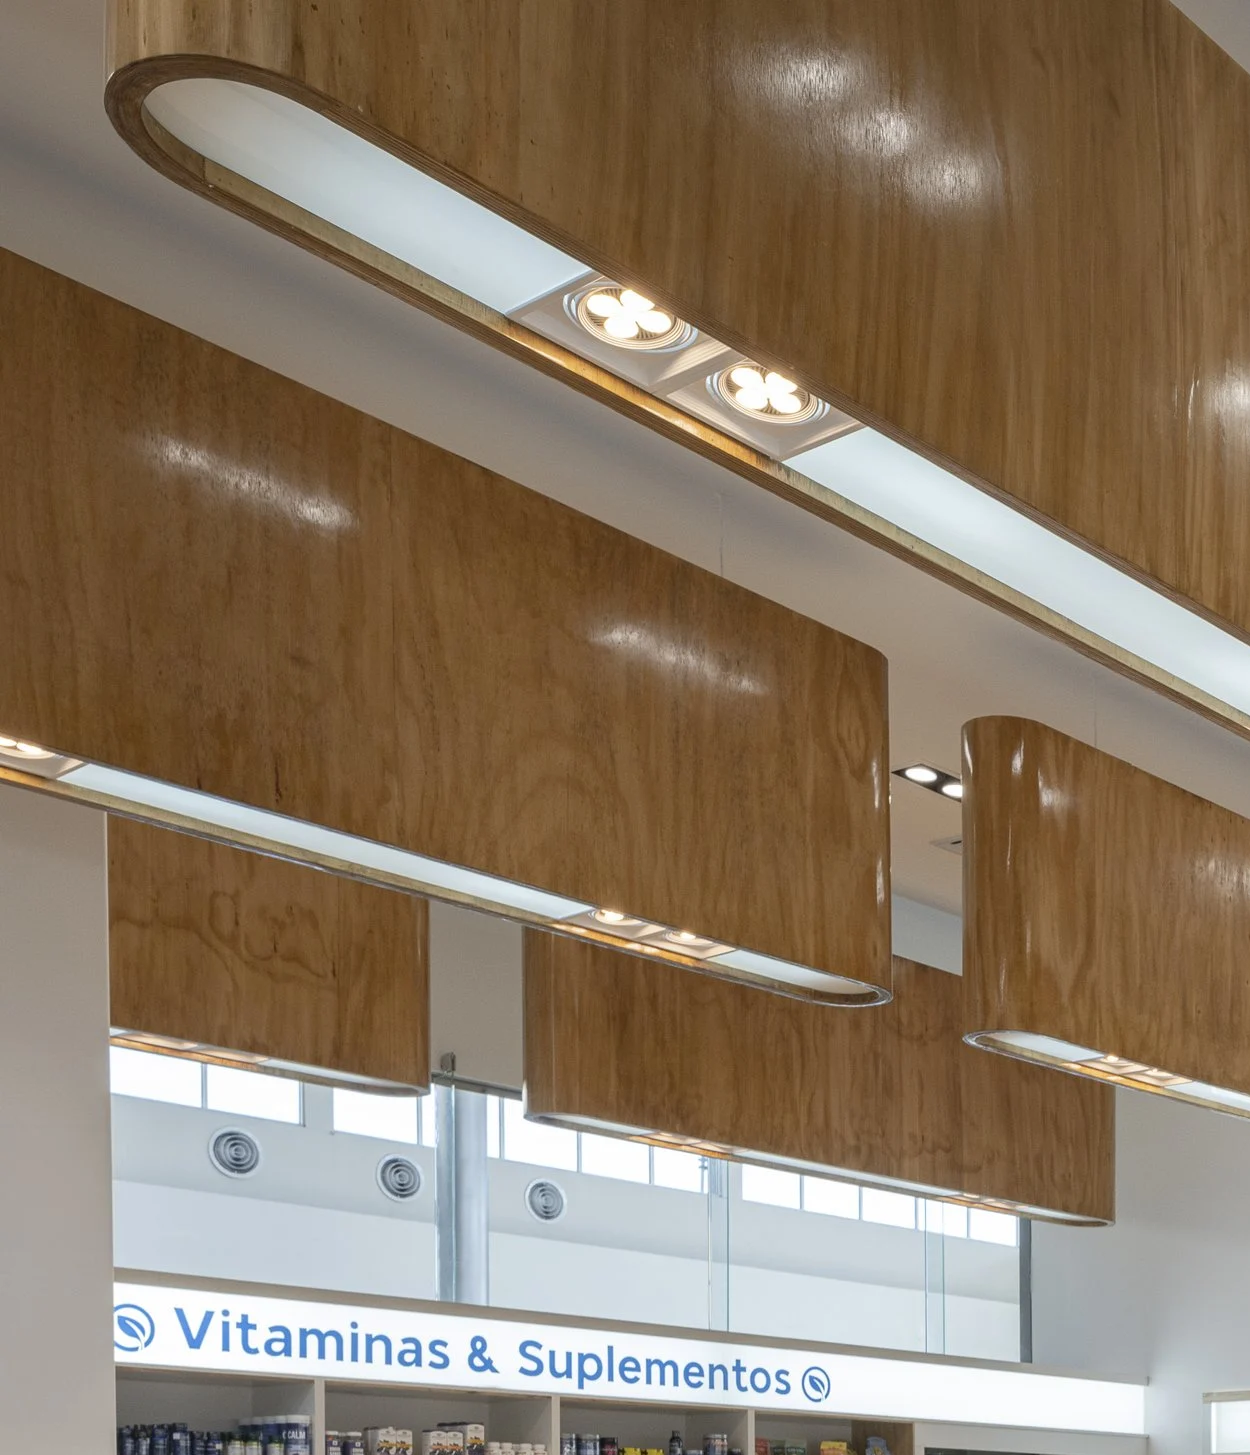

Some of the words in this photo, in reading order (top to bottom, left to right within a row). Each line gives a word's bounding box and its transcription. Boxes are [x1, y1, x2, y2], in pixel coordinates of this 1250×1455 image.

[174, 1307, 450, 1369] Vitaminas
[467, 1335, 499, 1373] &
[518, 1340, 791, 1395] Suplementos
